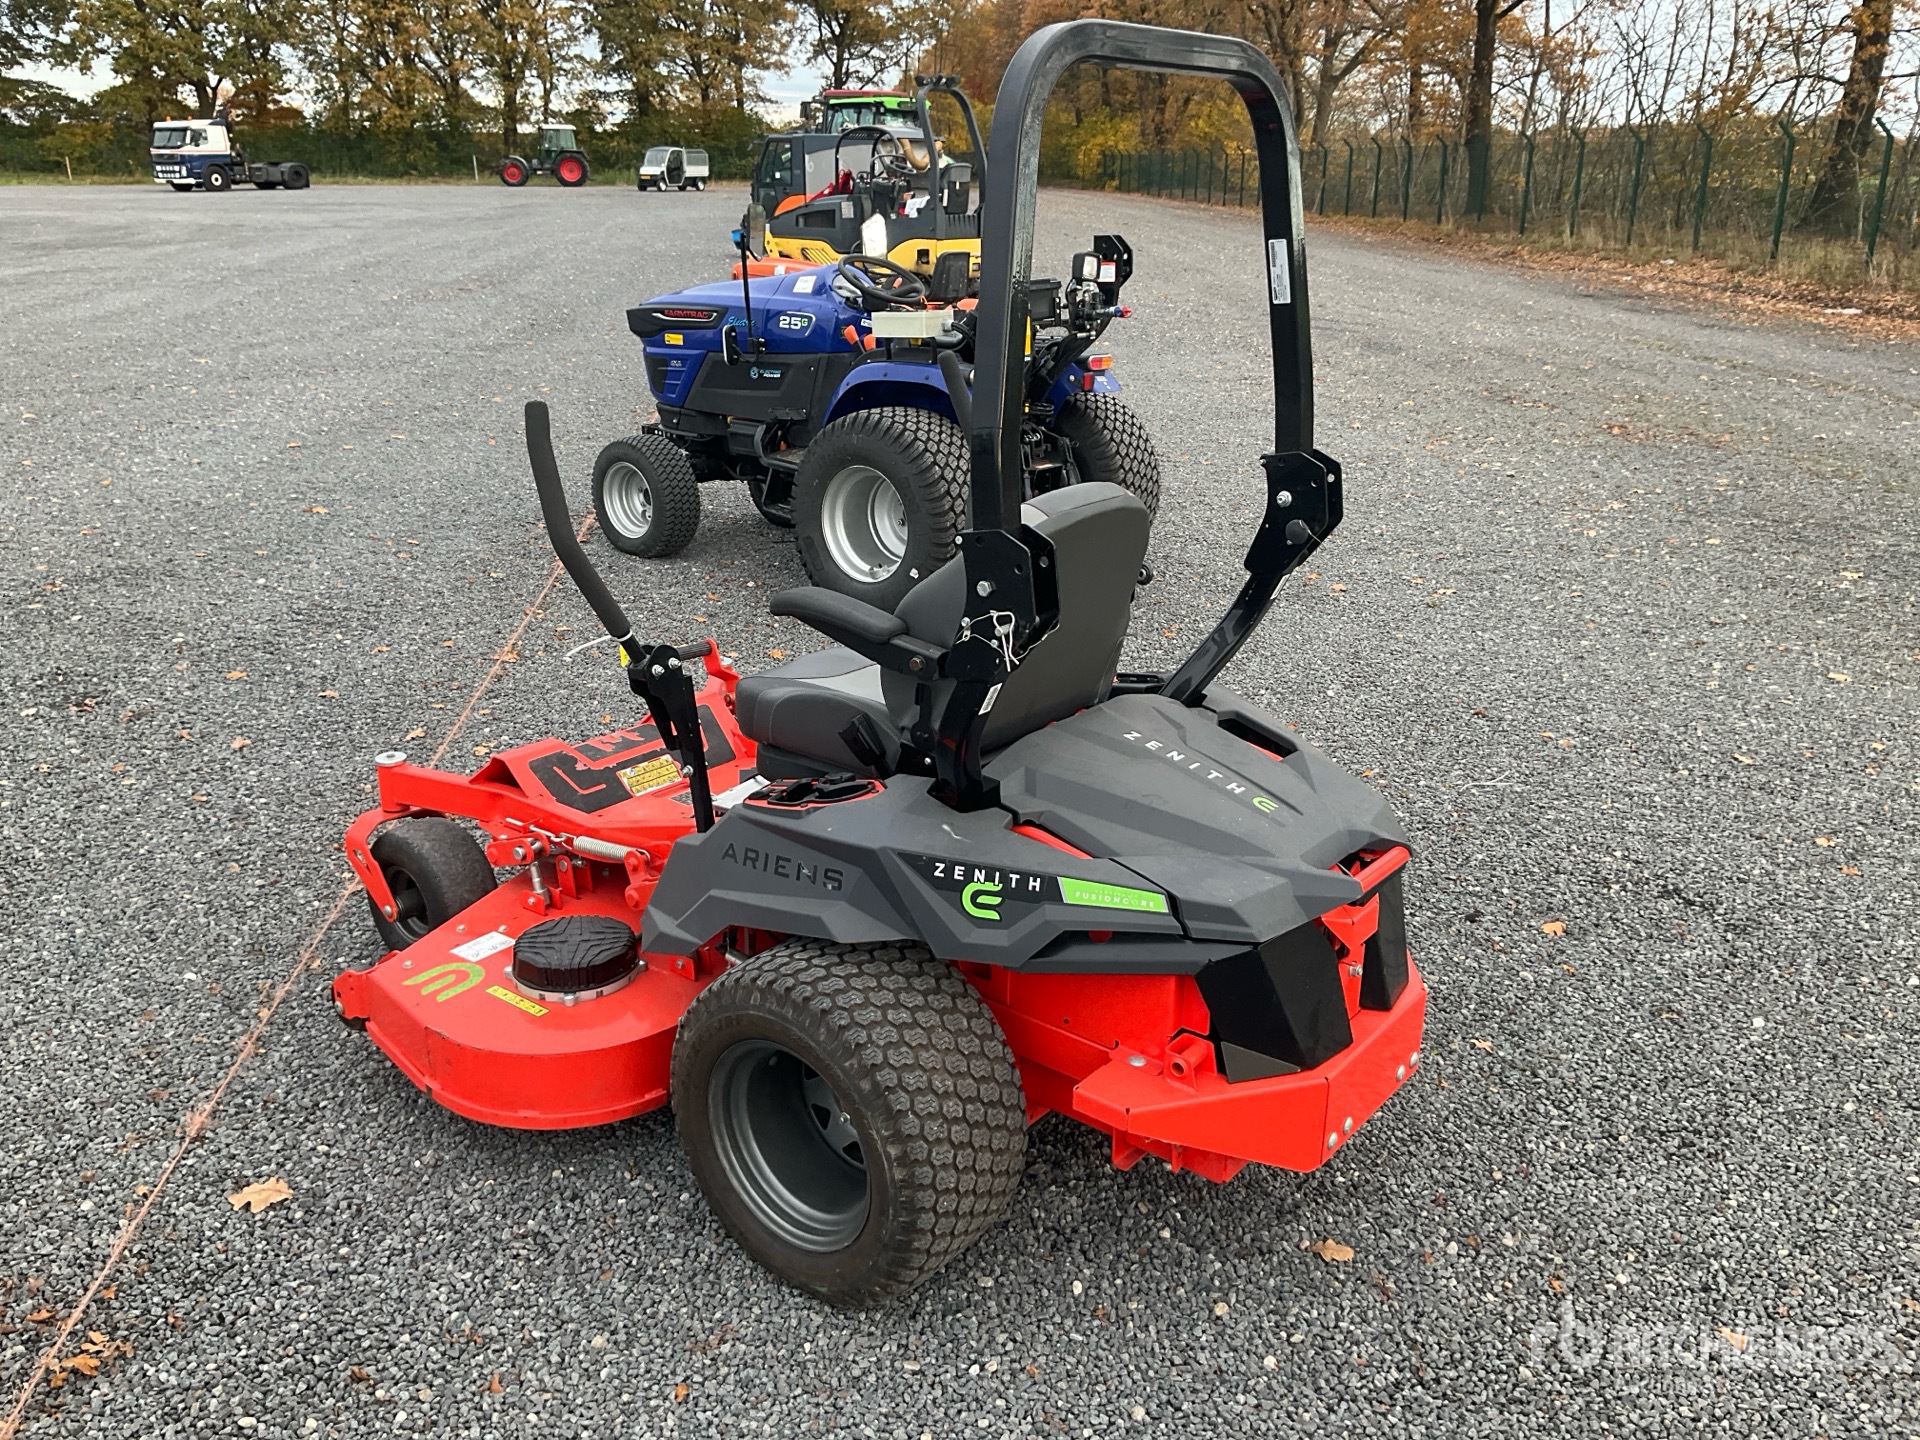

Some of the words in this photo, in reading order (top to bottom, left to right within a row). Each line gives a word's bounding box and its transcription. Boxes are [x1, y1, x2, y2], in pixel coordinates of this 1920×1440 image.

[664, 309, 709, 319] FARMTRAC
[1123, 731, 1246, 794] ZENITH
[721, 842, 844, 891] ARIENS
[933, 862, 1041, 892] ZENITH
